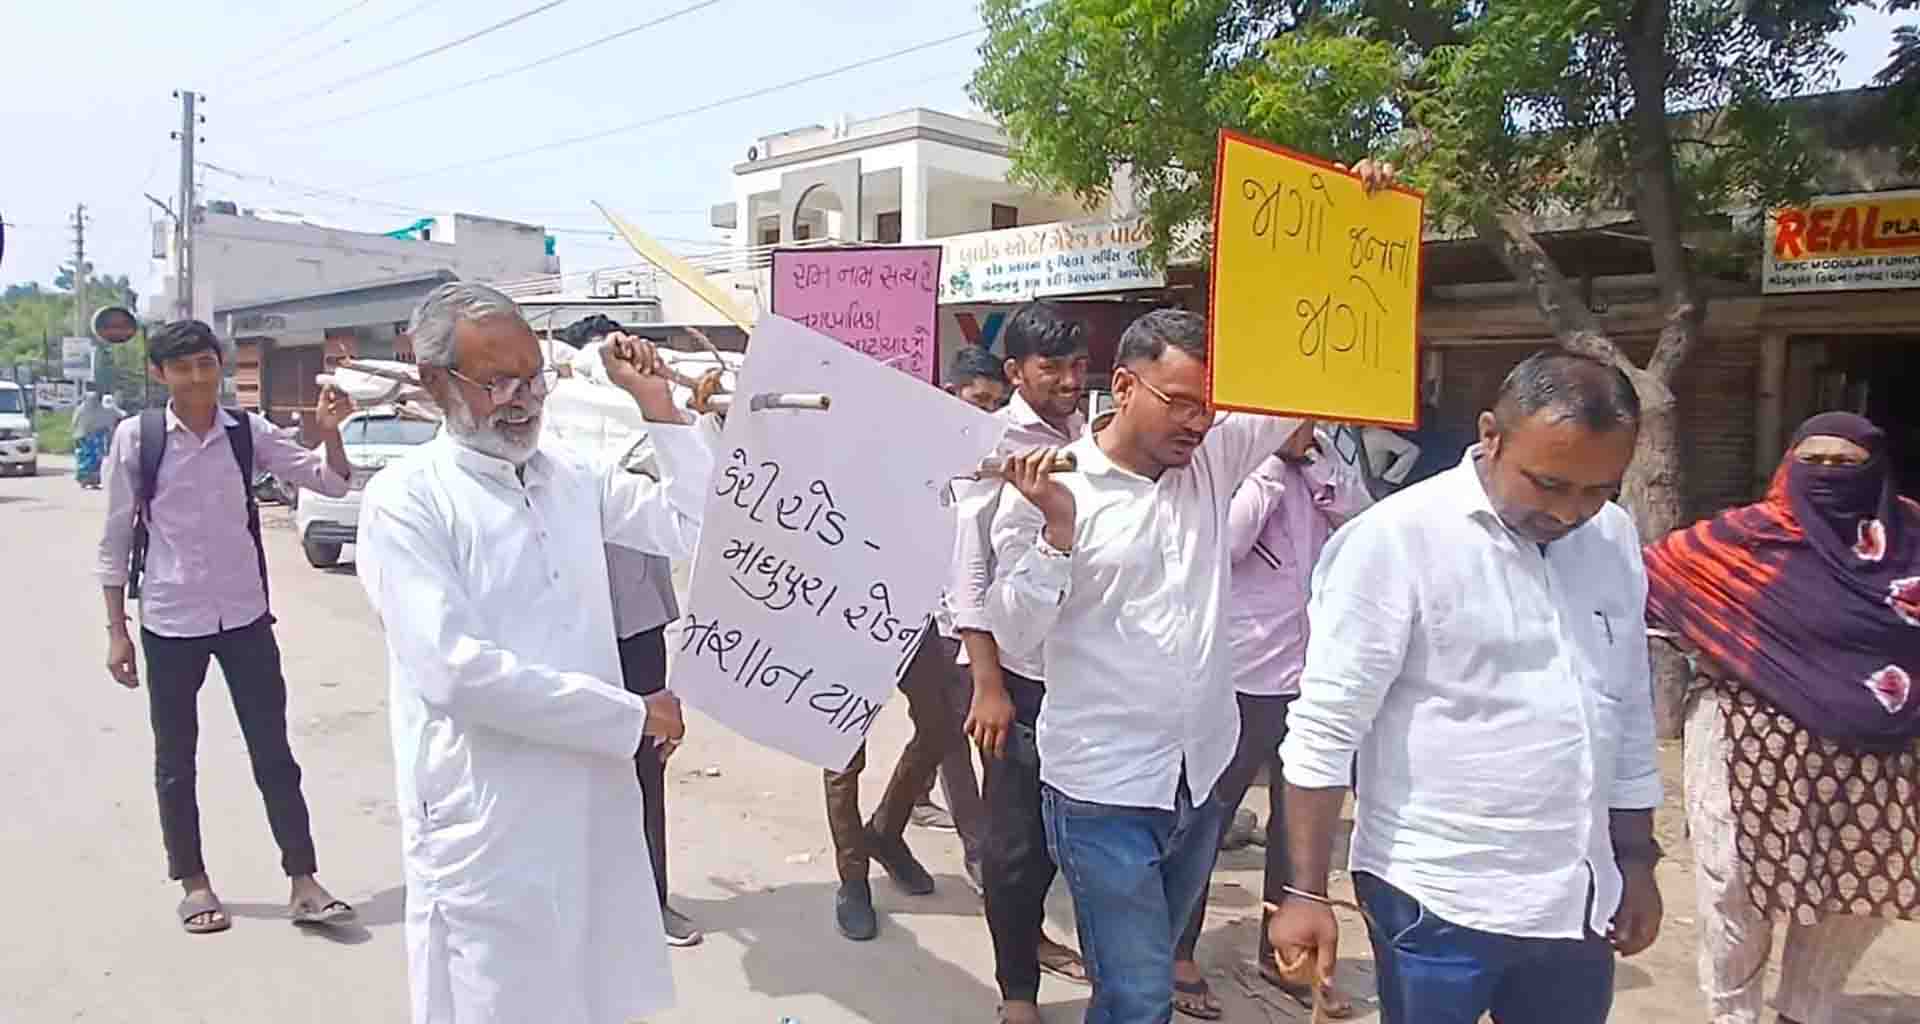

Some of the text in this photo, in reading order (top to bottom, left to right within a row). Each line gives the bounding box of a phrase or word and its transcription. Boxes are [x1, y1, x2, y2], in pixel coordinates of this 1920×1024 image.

[1241, 172, 1414, 289] જાગો જનતા
[1774, 207, 1892, 256] REAL
[837, 266, 873, 288] નામ
[1295, 274, 1388, 373] જાગો
[776, 480, 847, 546] રોડ
